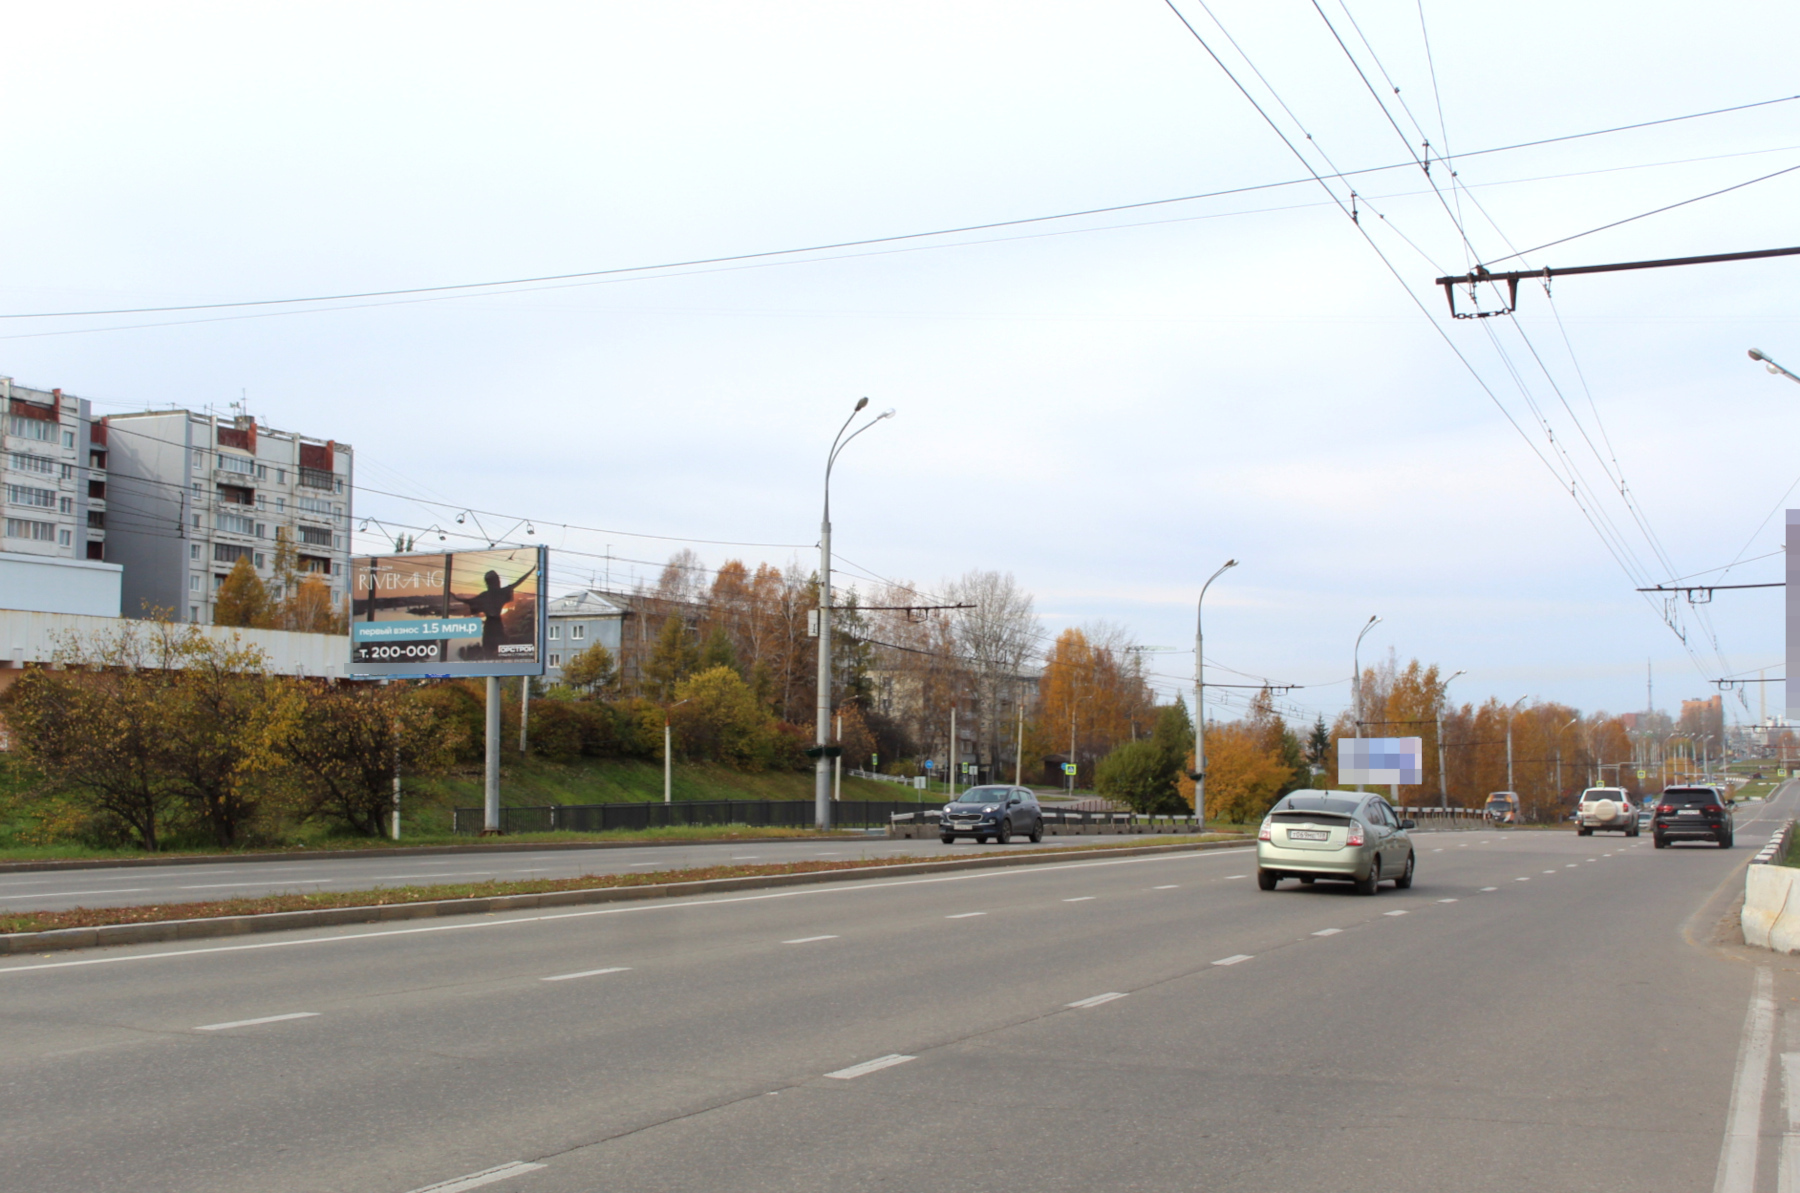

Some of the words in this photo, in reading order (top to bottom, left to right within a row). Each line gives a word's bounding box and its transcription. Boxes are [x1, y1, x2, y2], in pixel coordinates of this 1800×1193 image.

[359, 627, 392, 637] первый
[393, 626, 419, 635] взнос
[422, 623, 439, 634] 1.5
[441, 622, 477, 635] млн.р
[371, 645, 438, 658] 200-000
